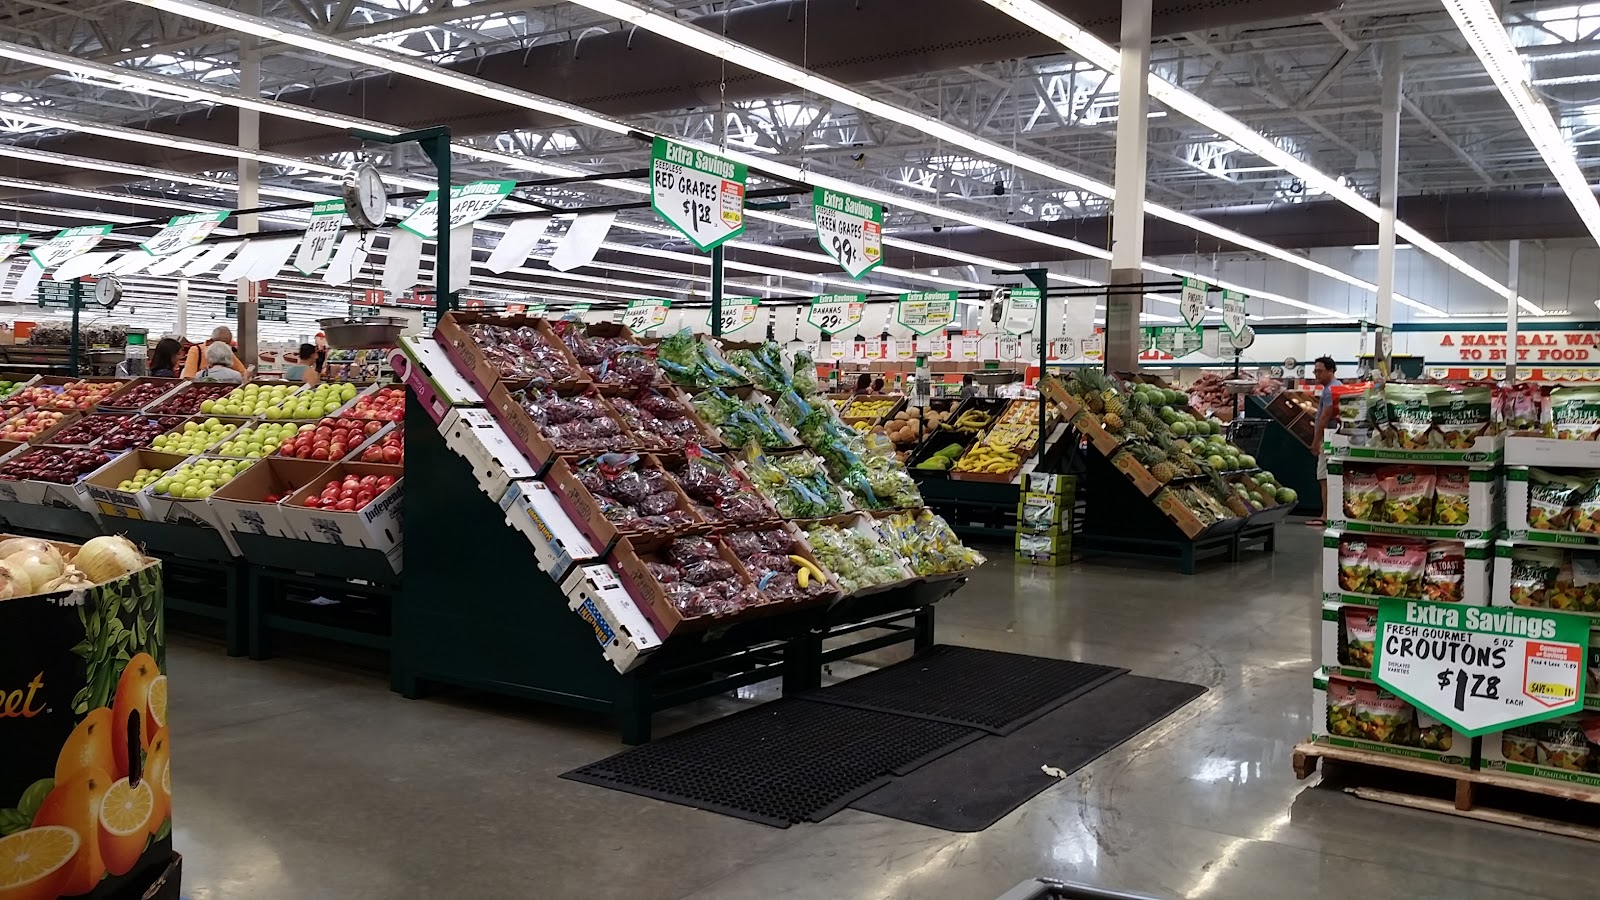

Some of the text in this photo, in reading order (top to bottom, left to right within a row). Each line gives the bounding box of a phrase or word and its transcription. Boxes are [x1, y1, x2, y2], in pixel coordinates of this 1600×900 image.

[666, 142, 735, 178] Extra Savings
[655, 160, 682, 174] SEEDLESS
[460, 182, 501, 197] Savings
[655, 170, 717, 201] RED GRAPES
[451, 199, 497, 213] APPLES
[823, 191, 873, 219] Extra Savings
[308, 220, 339, 232] APPLES
[818, 215, 861, 239] GREEN GRAPES
[820, 294, 858, 303] Extra Savings
[907, 292, 950, 301] Extra Savings
[813, 306, 841, 314] BANANAS
[1440, 335, 1454, 346] A
[1460, 349, 1482, 360] TO
[1538, 349, 1588, 360] FOOD
[1406, 602, 1556, 639] Extra Savings
[1386, 624, 1473, 643] FRESH GOURMET
[1502, 638, 1513, 648] OZ
[1385, 636, 1506, 669] CROUTONS
[1531, 683, 1546, 694] SAVE
[1505, 698, 1524, 707] EACH
[1532, 768, 1567, 780] PREMIUM
